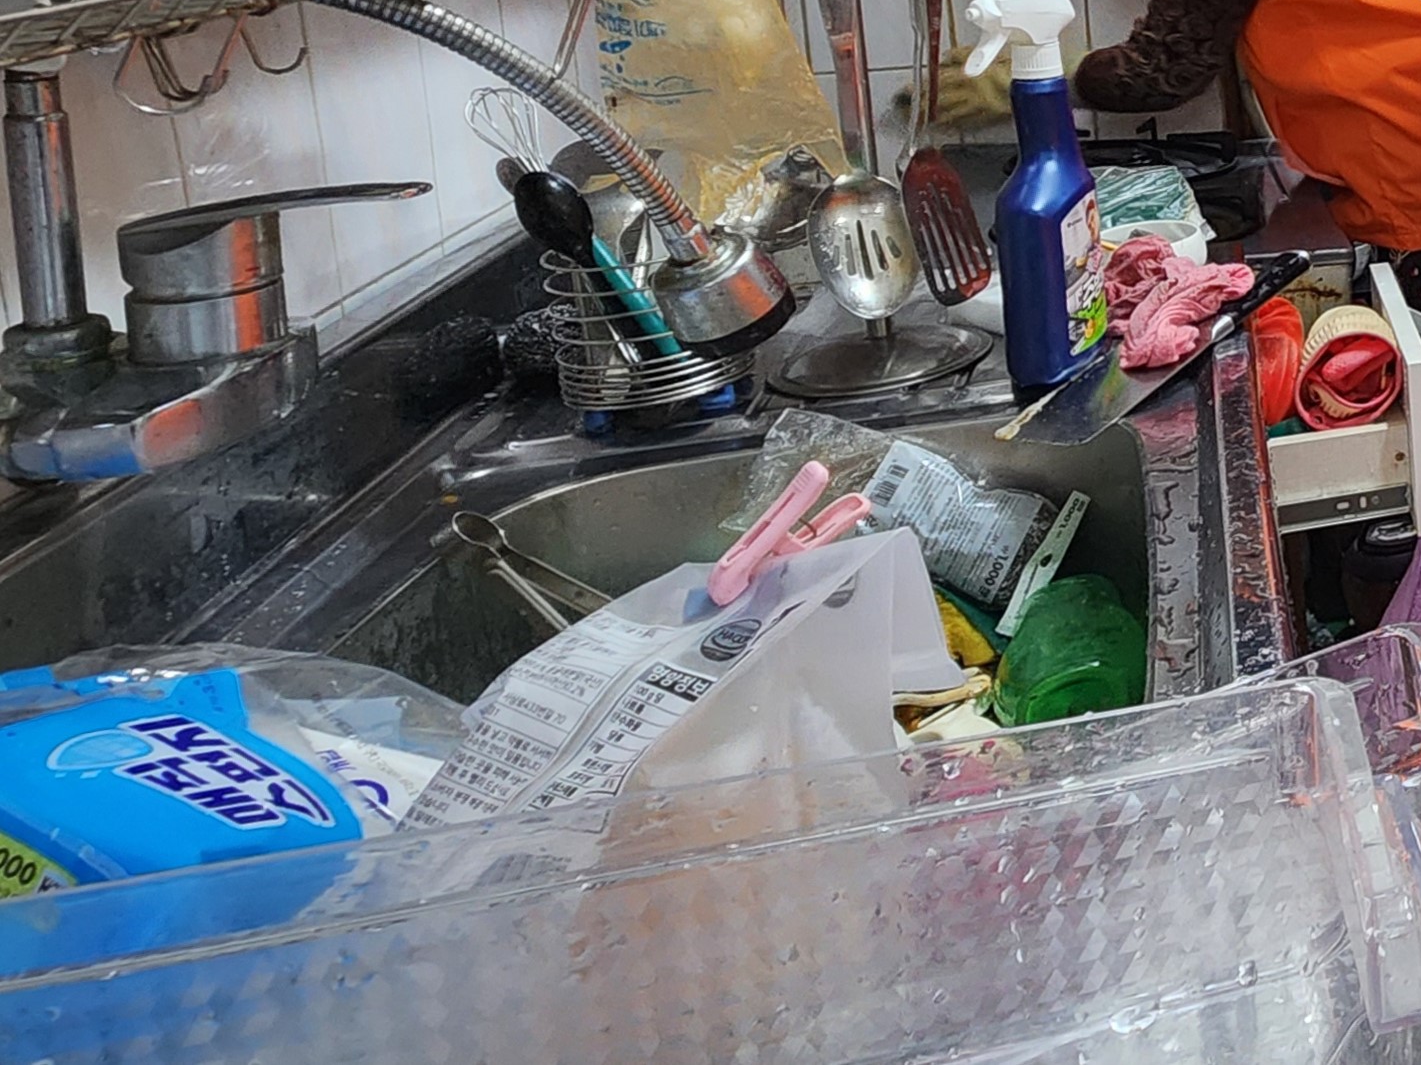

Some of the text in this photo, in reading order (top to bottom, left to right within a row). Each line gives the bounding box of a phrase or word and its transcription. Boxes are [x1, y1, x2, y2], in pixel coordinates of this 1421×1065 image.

[648, 663, 710, 697] 영양정보
[121, 755, 281, 826] 매직
[127, 716, 331, 823] 스펀지
